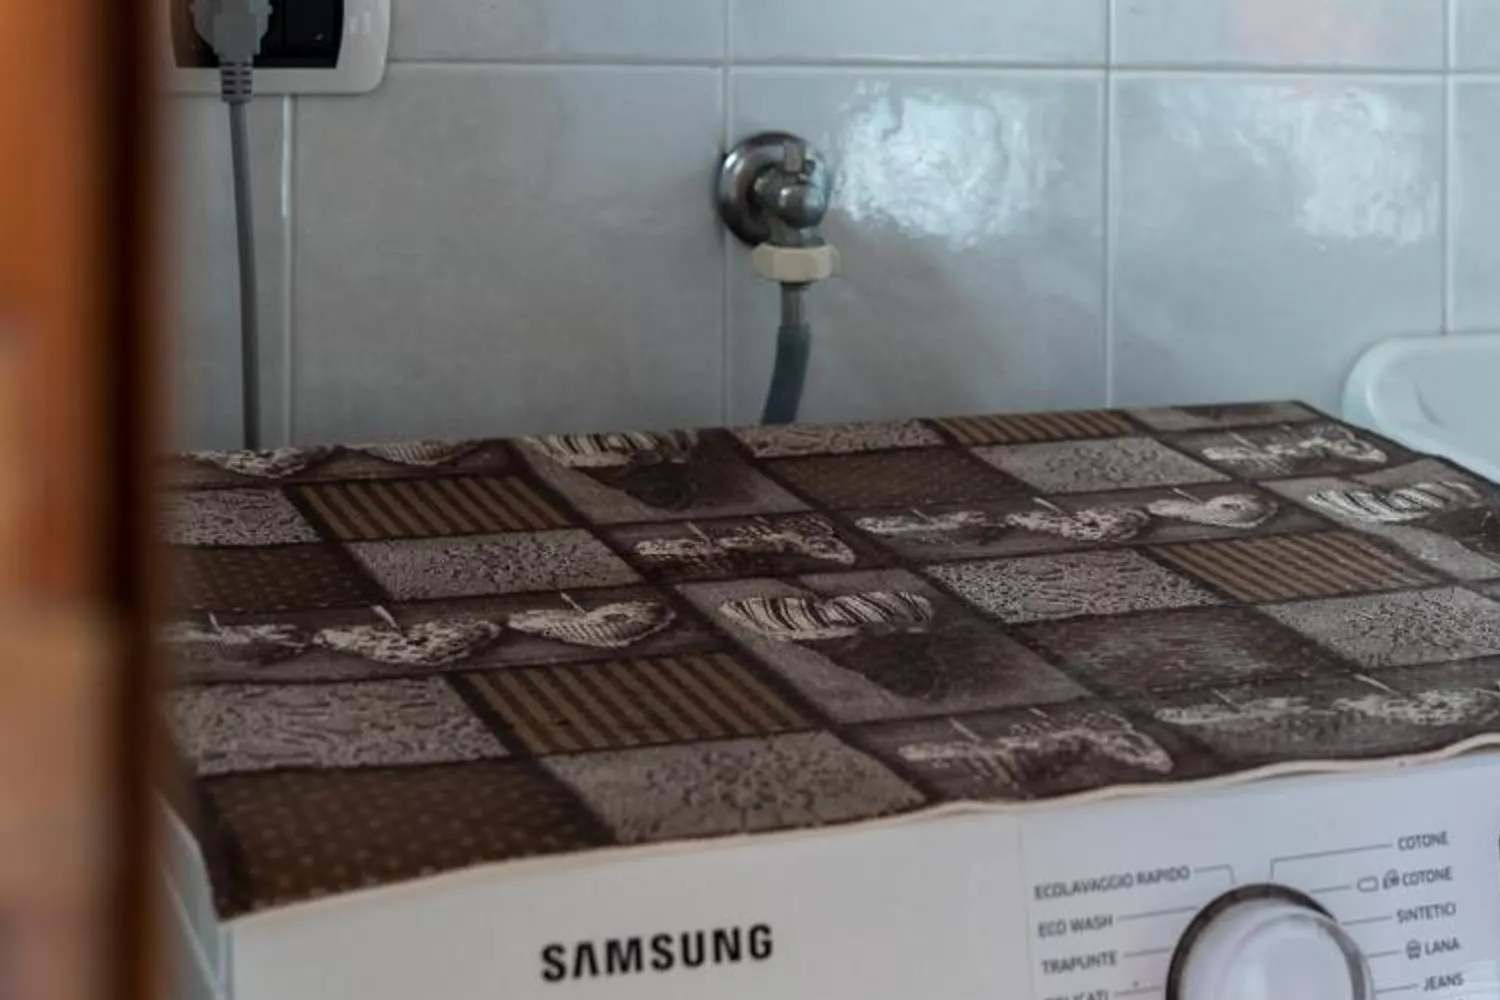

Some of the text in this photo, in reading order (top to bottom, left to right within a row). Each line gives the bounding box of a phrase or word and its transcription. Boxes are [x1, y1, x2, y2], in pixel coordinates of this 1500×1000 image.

[1398, 831, 1449, 851] COTONE
[1136, 865, 1190, 886] RAPIDO
[1402, 866, 1453, 887] COTONE
[1397, 902, 1456, 923] SINTETICI
[1038, 914, 1114, 939] ECO WASH
[540, 924, 775, 982] SAMSUNG
[1424, 937, 1460, 956] LANA
[1041, 951, 1118, 974] TRAPUNTE
[1423, 972, 1465, 991] JEANS
